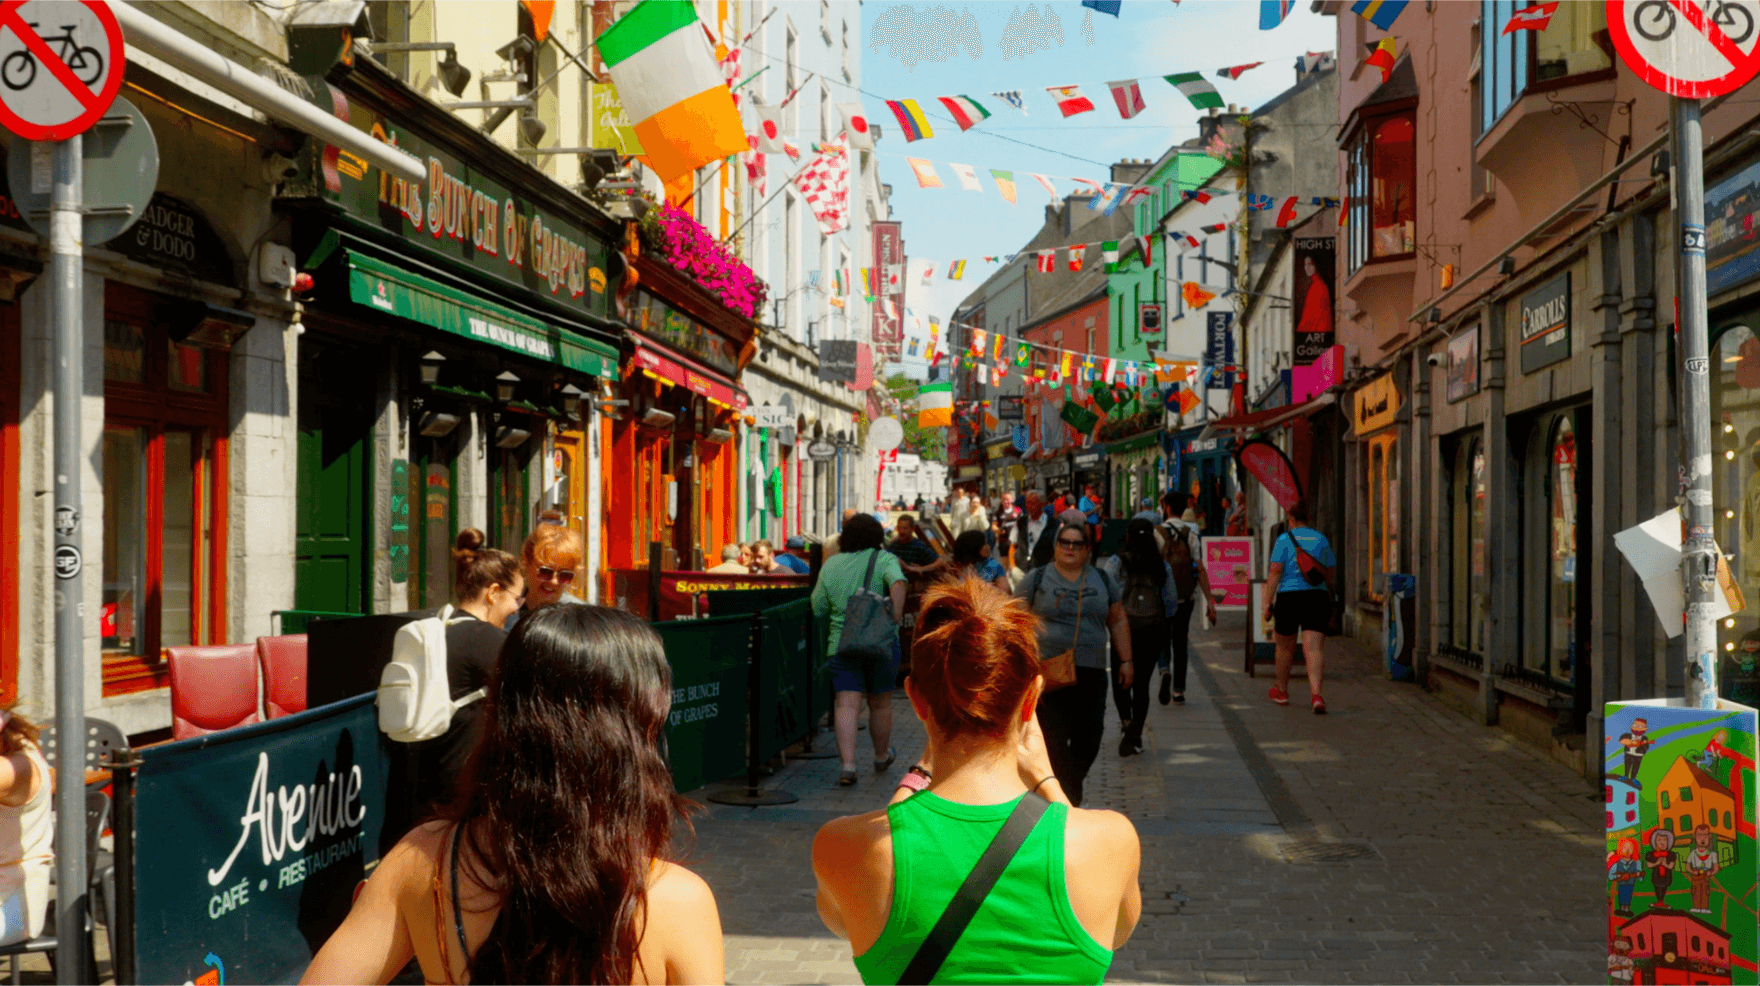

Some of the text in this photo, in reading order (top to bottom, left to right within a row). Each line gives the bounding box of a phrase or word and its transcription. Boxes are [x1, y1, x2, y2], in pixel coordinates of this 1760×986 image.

[142, 204, 195, 238] ADGER
[428, 155, 498, 256] BUNCH
[504, 198, 527, 267] OF
[530, 215, 585, 298] GRAPES
[152, 229, 195, 261] DODO
[1297, 240, 1323, 250] HIGH
[1522, 294, 1566, 339] CARROLLS
[1214, 313, 1226, 388] PORTWEST
[1305, 332, 1325, 343] ART
[676, 580, 730, 593] SONNY
[672, 681, 720, 704] HE BUNCH
[670, 702, 719, 726] OF GRAPES
[207, 752, 367, 886] Avenue
[208, 831, 366, 919] CAFÉ RESTAURANT
